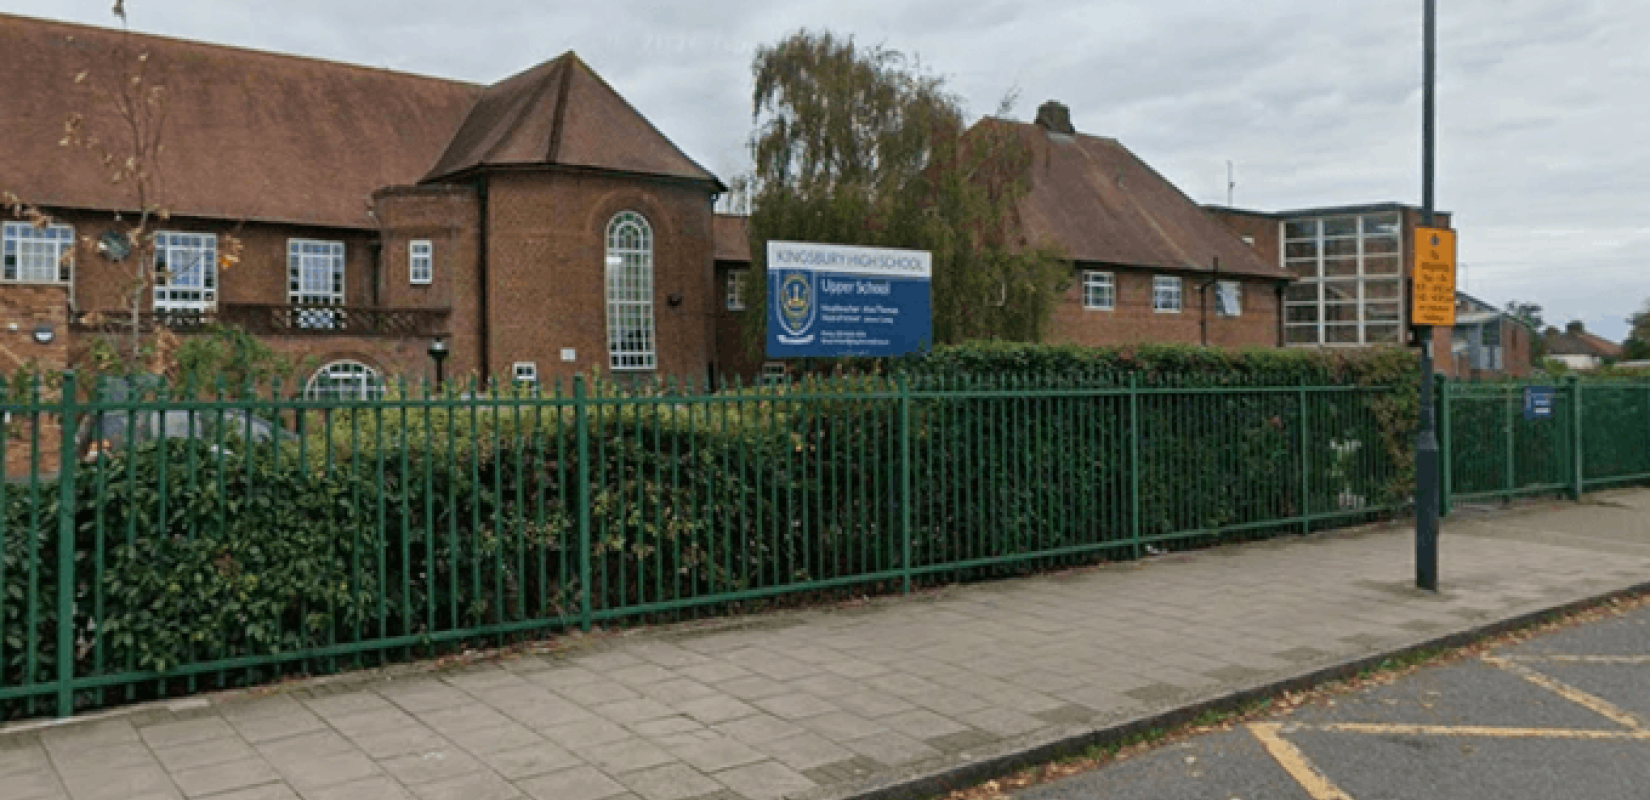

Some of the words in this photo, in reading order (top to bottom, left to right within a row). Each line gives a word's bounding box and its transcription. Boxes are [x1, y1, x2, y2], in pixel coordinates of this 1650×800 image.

[776, 250, 845, 265] KINGSBURY
[848, 253, 876, 267] HIGH
[878, 255, 923, 271] SCHOOL
[820, 278, 854, 296] Upper
[856, 280, 891, 296] School
